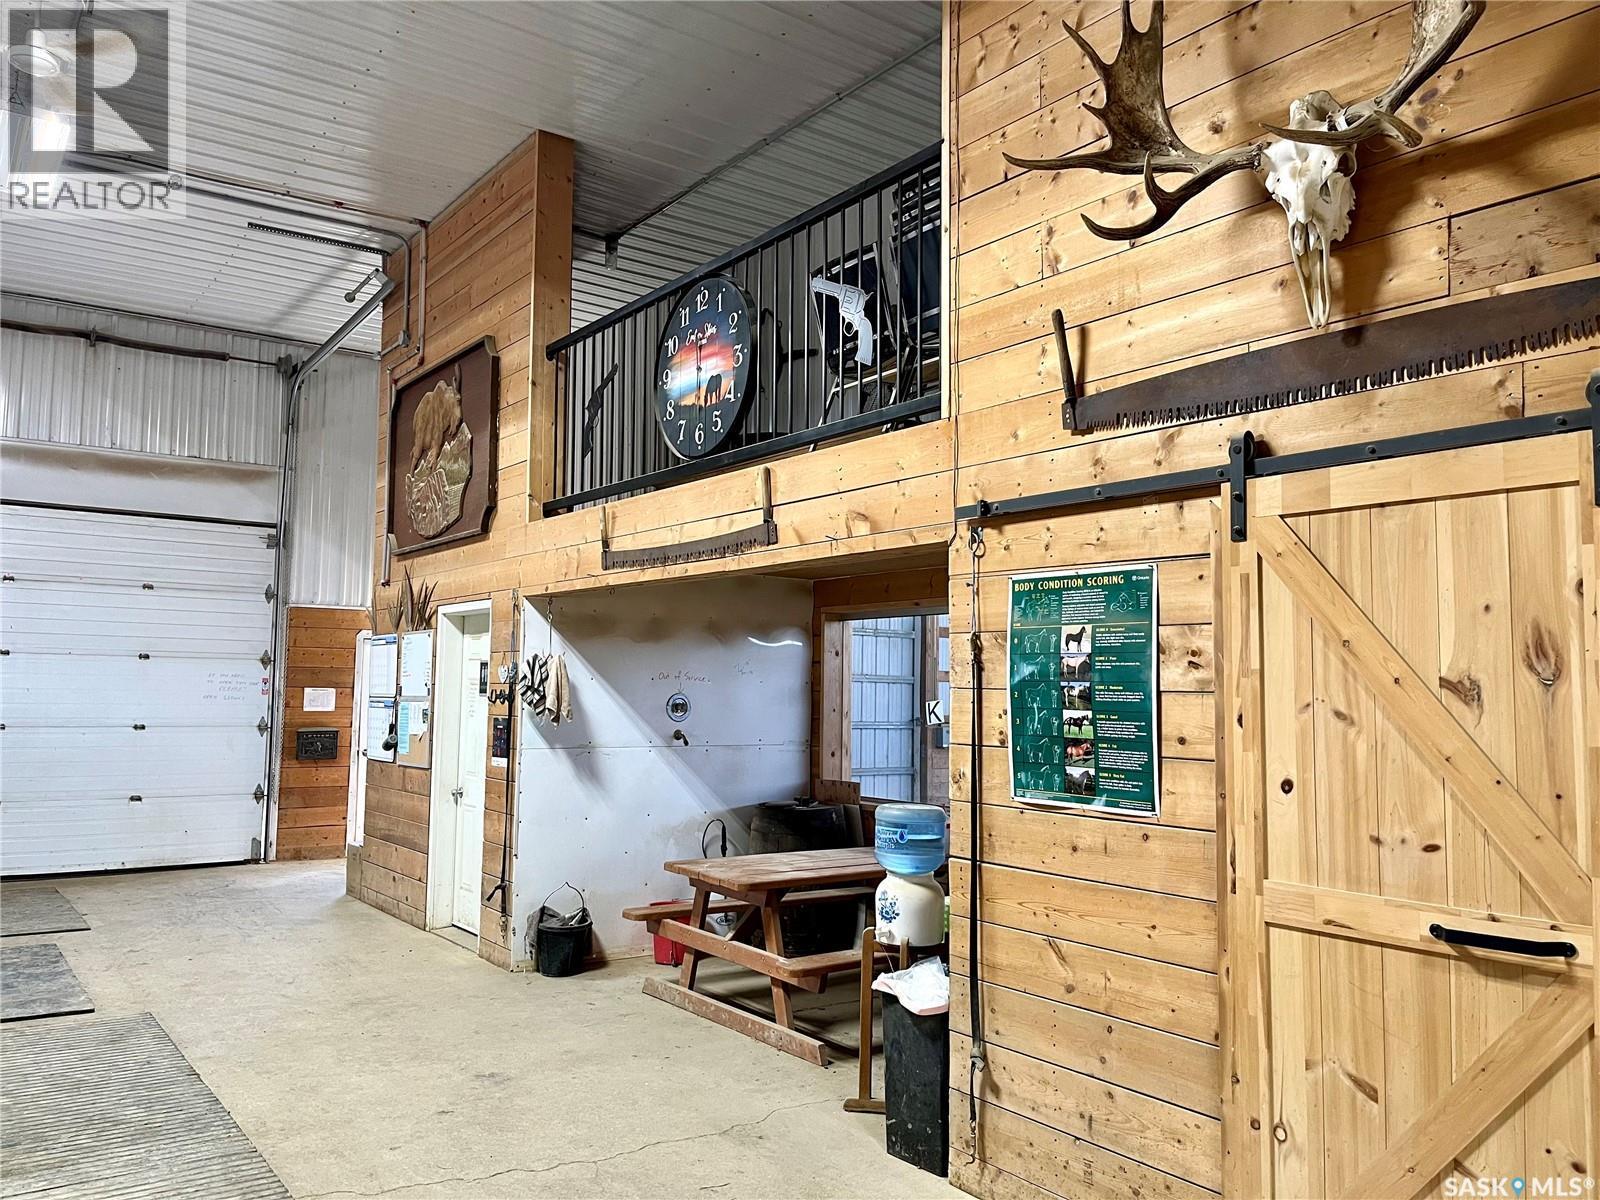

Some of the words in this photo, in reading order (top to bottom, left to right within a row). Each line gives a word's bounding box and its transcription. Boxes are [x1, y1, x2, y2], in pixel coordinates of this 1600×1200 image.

[695, 289, 709, 313] 12
[716, 292, 722, 312] 1
[680, 306, 690, 328] 11
[728, 312, 738, 334] 2
[665, 335, 678, 358] 10
[732, 344, 742, 367] 3
[662, 370, 672, 390] 9
[725, 380, 736, 402] 4
[666, 400, 674, 420] 8
[712, 410, 722, 432] 5
[678, 420, 686, 442] 7
[694, 422, 704, 444] 6
[1014, 582, 1035, 592] BODY
[1038, 578, 1084, 590] CONDITION
[1087, 574, 1124, 587] SCORING
[928, 701, 942, 724] K
